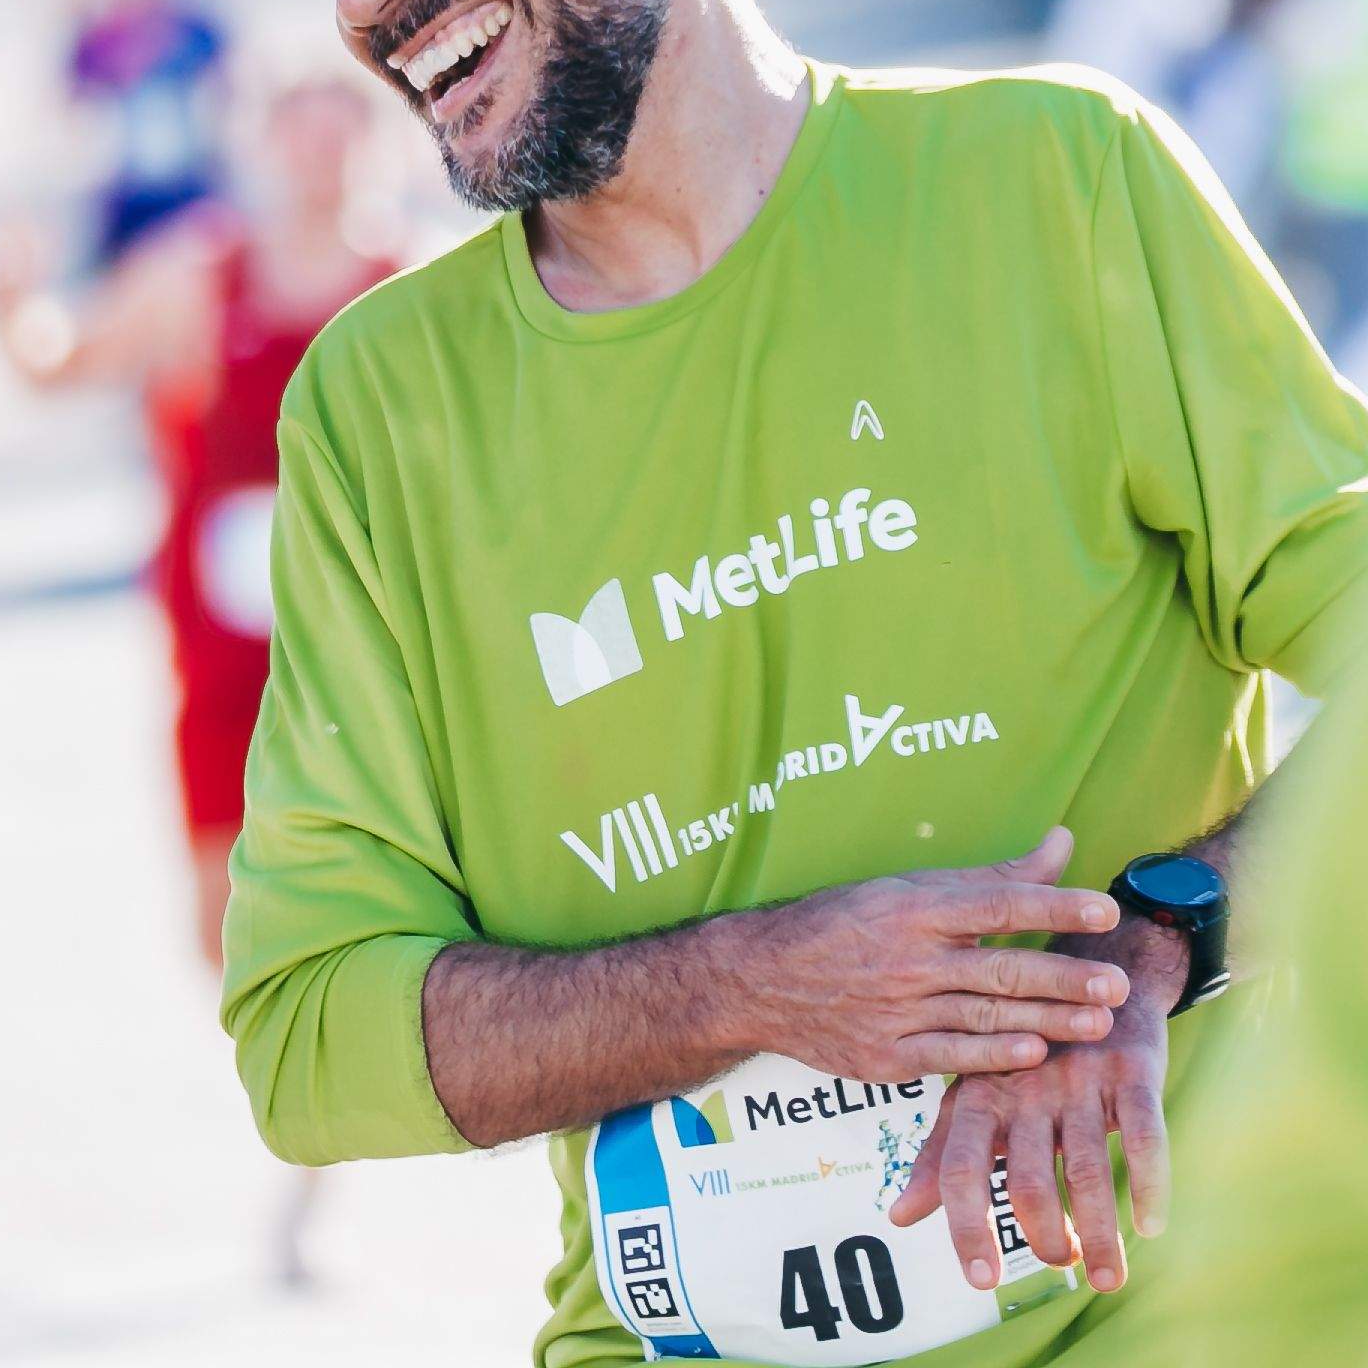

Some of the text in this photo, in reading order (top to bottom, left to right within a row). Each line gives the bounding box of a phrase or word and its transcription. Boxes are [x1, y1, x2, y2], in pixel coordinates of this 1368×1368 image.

[652, 487, 919, 642] MetLife
[559, 793, 679, 893] VIII
[677, 802, 740, 857] 15K
[689, 1168, 732, 1197] VIII
[735, 1177, 766, 1192] 15KM
[771, 1172, 819, 1187] MADRID
[779, 1234, 905, 1343] 40
